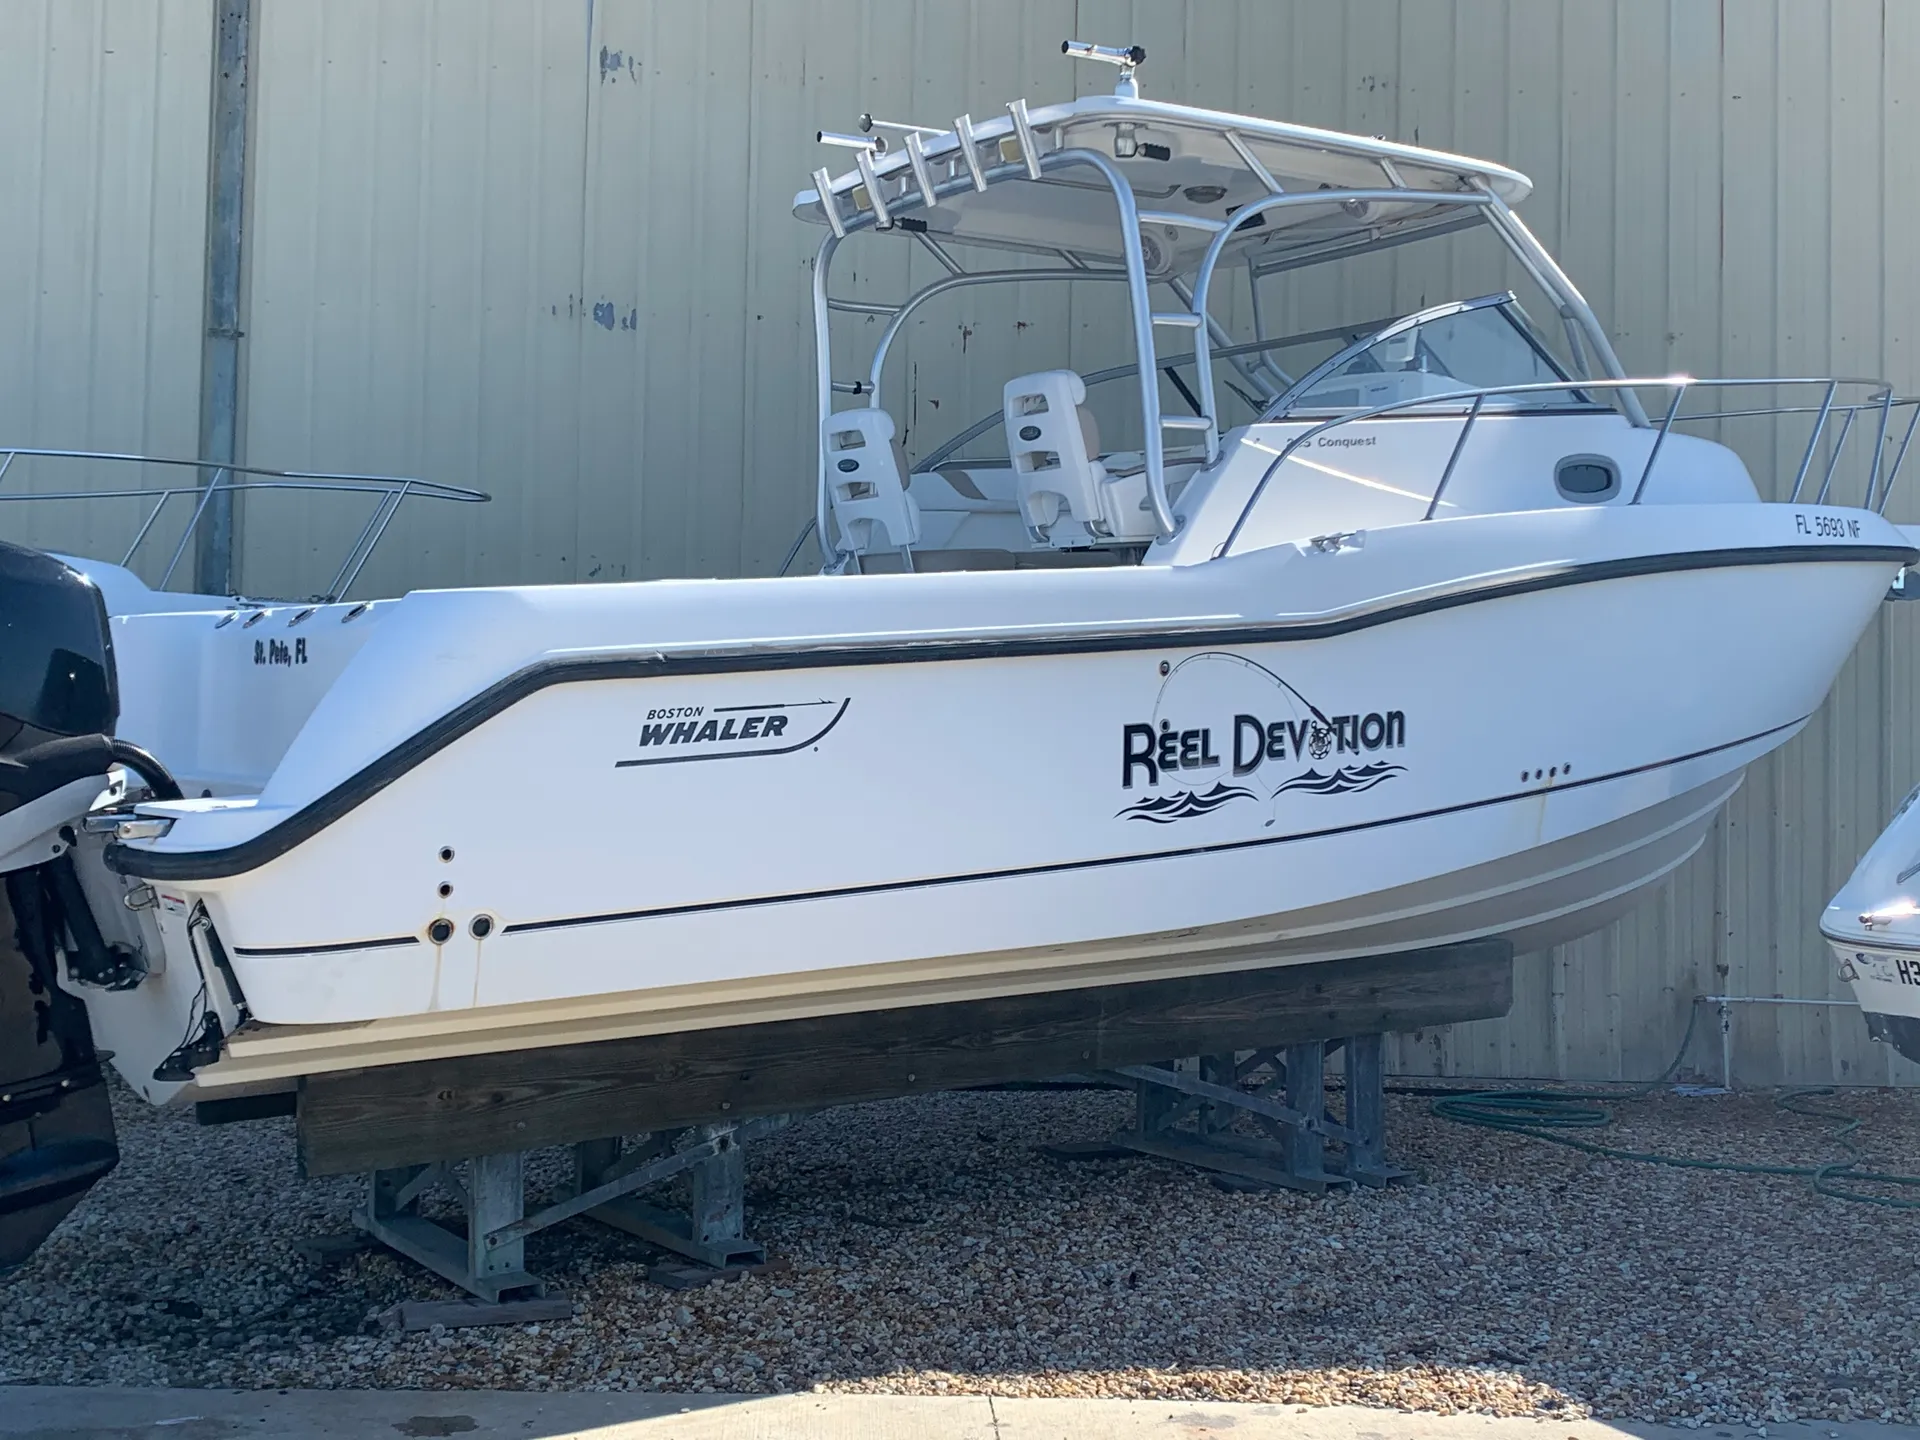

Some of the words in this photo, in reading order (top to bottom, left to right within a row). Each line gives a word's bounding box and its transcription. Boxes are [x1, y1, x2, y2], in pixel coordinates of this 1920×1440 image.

[1318, 436, 1376, 449] Conquest
[1795, 514, 1811, 534] FL
[1815, 516, 1845, 537] 5693
[1847, 519, 1861, 538] NF
[254, 639, 266, 665] St.
[269, 638, 291, 667] Pete,
[295, 637, 308, 664] FL
[646, 706, 704, 720] BOSTON
[639, 715, 788, 747] WHALER
